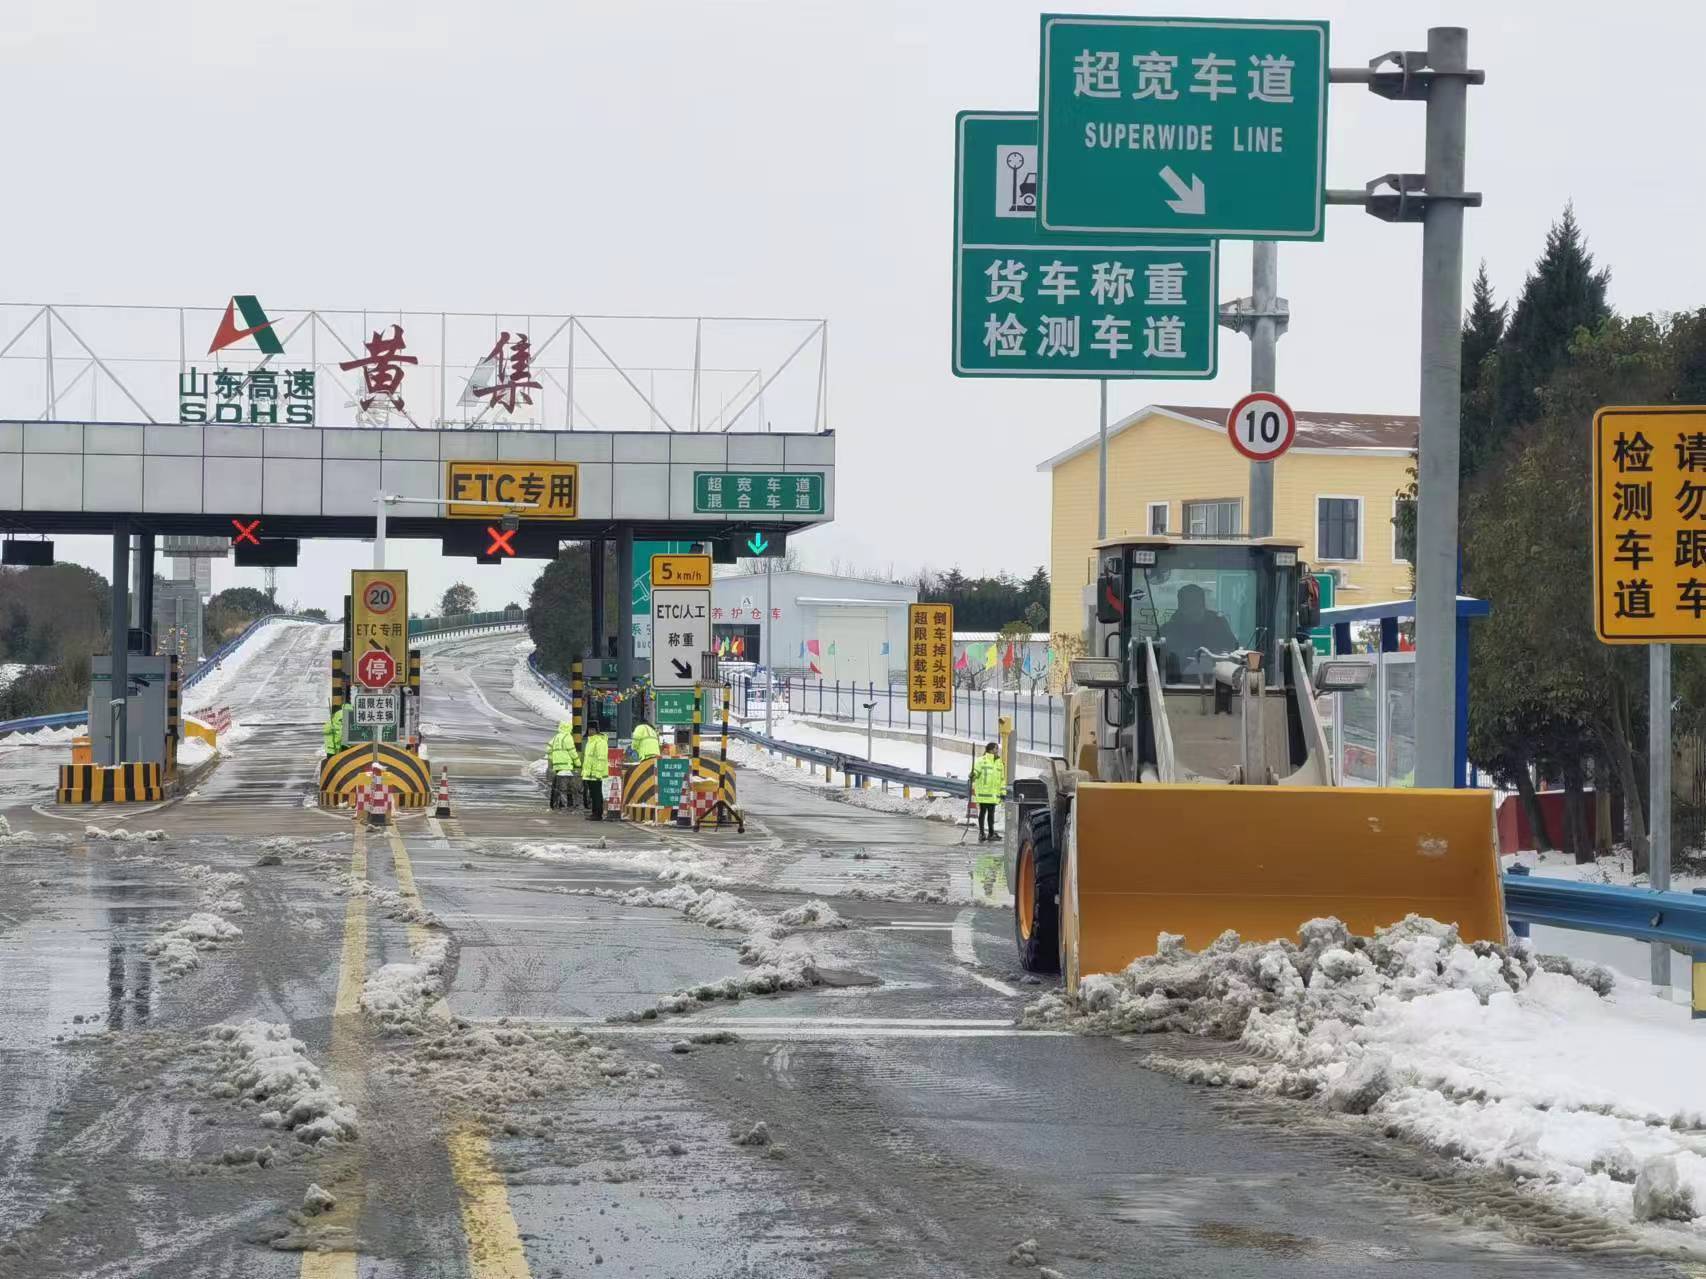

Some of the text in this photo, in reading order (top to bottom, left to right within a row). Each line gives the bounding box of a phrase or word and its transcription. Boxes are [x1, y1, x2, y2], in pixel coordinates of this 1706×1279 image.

[1073, 49, 1295, 103] 超宽车道
[1085, 122, 1283, 153] SUPERWIDE LINE
[984, 259, 1188, 305] 货车称重
[983, 312, 1188, 360] 检测车道
[180, 367, 315, 401] 山东高速
[180, 403, 314, 423] SDHS
[1246, 410, 1280, 443] 10
[707, 476, 810, 492] 超宽车道
[707, 493, 810, 510] 混合车道
[1612, 431, 1655, 618] 检测车道
[1674, 431, 1706, 619] 请勿跟车
[662, 563, 702, 581] 5 km/h
[369, 589, 390, 605] 20
[657, 604, 705, 619] ETC/人工
[668, 632, 695, 647] 称重
[365, 658, 388, 680] 停
